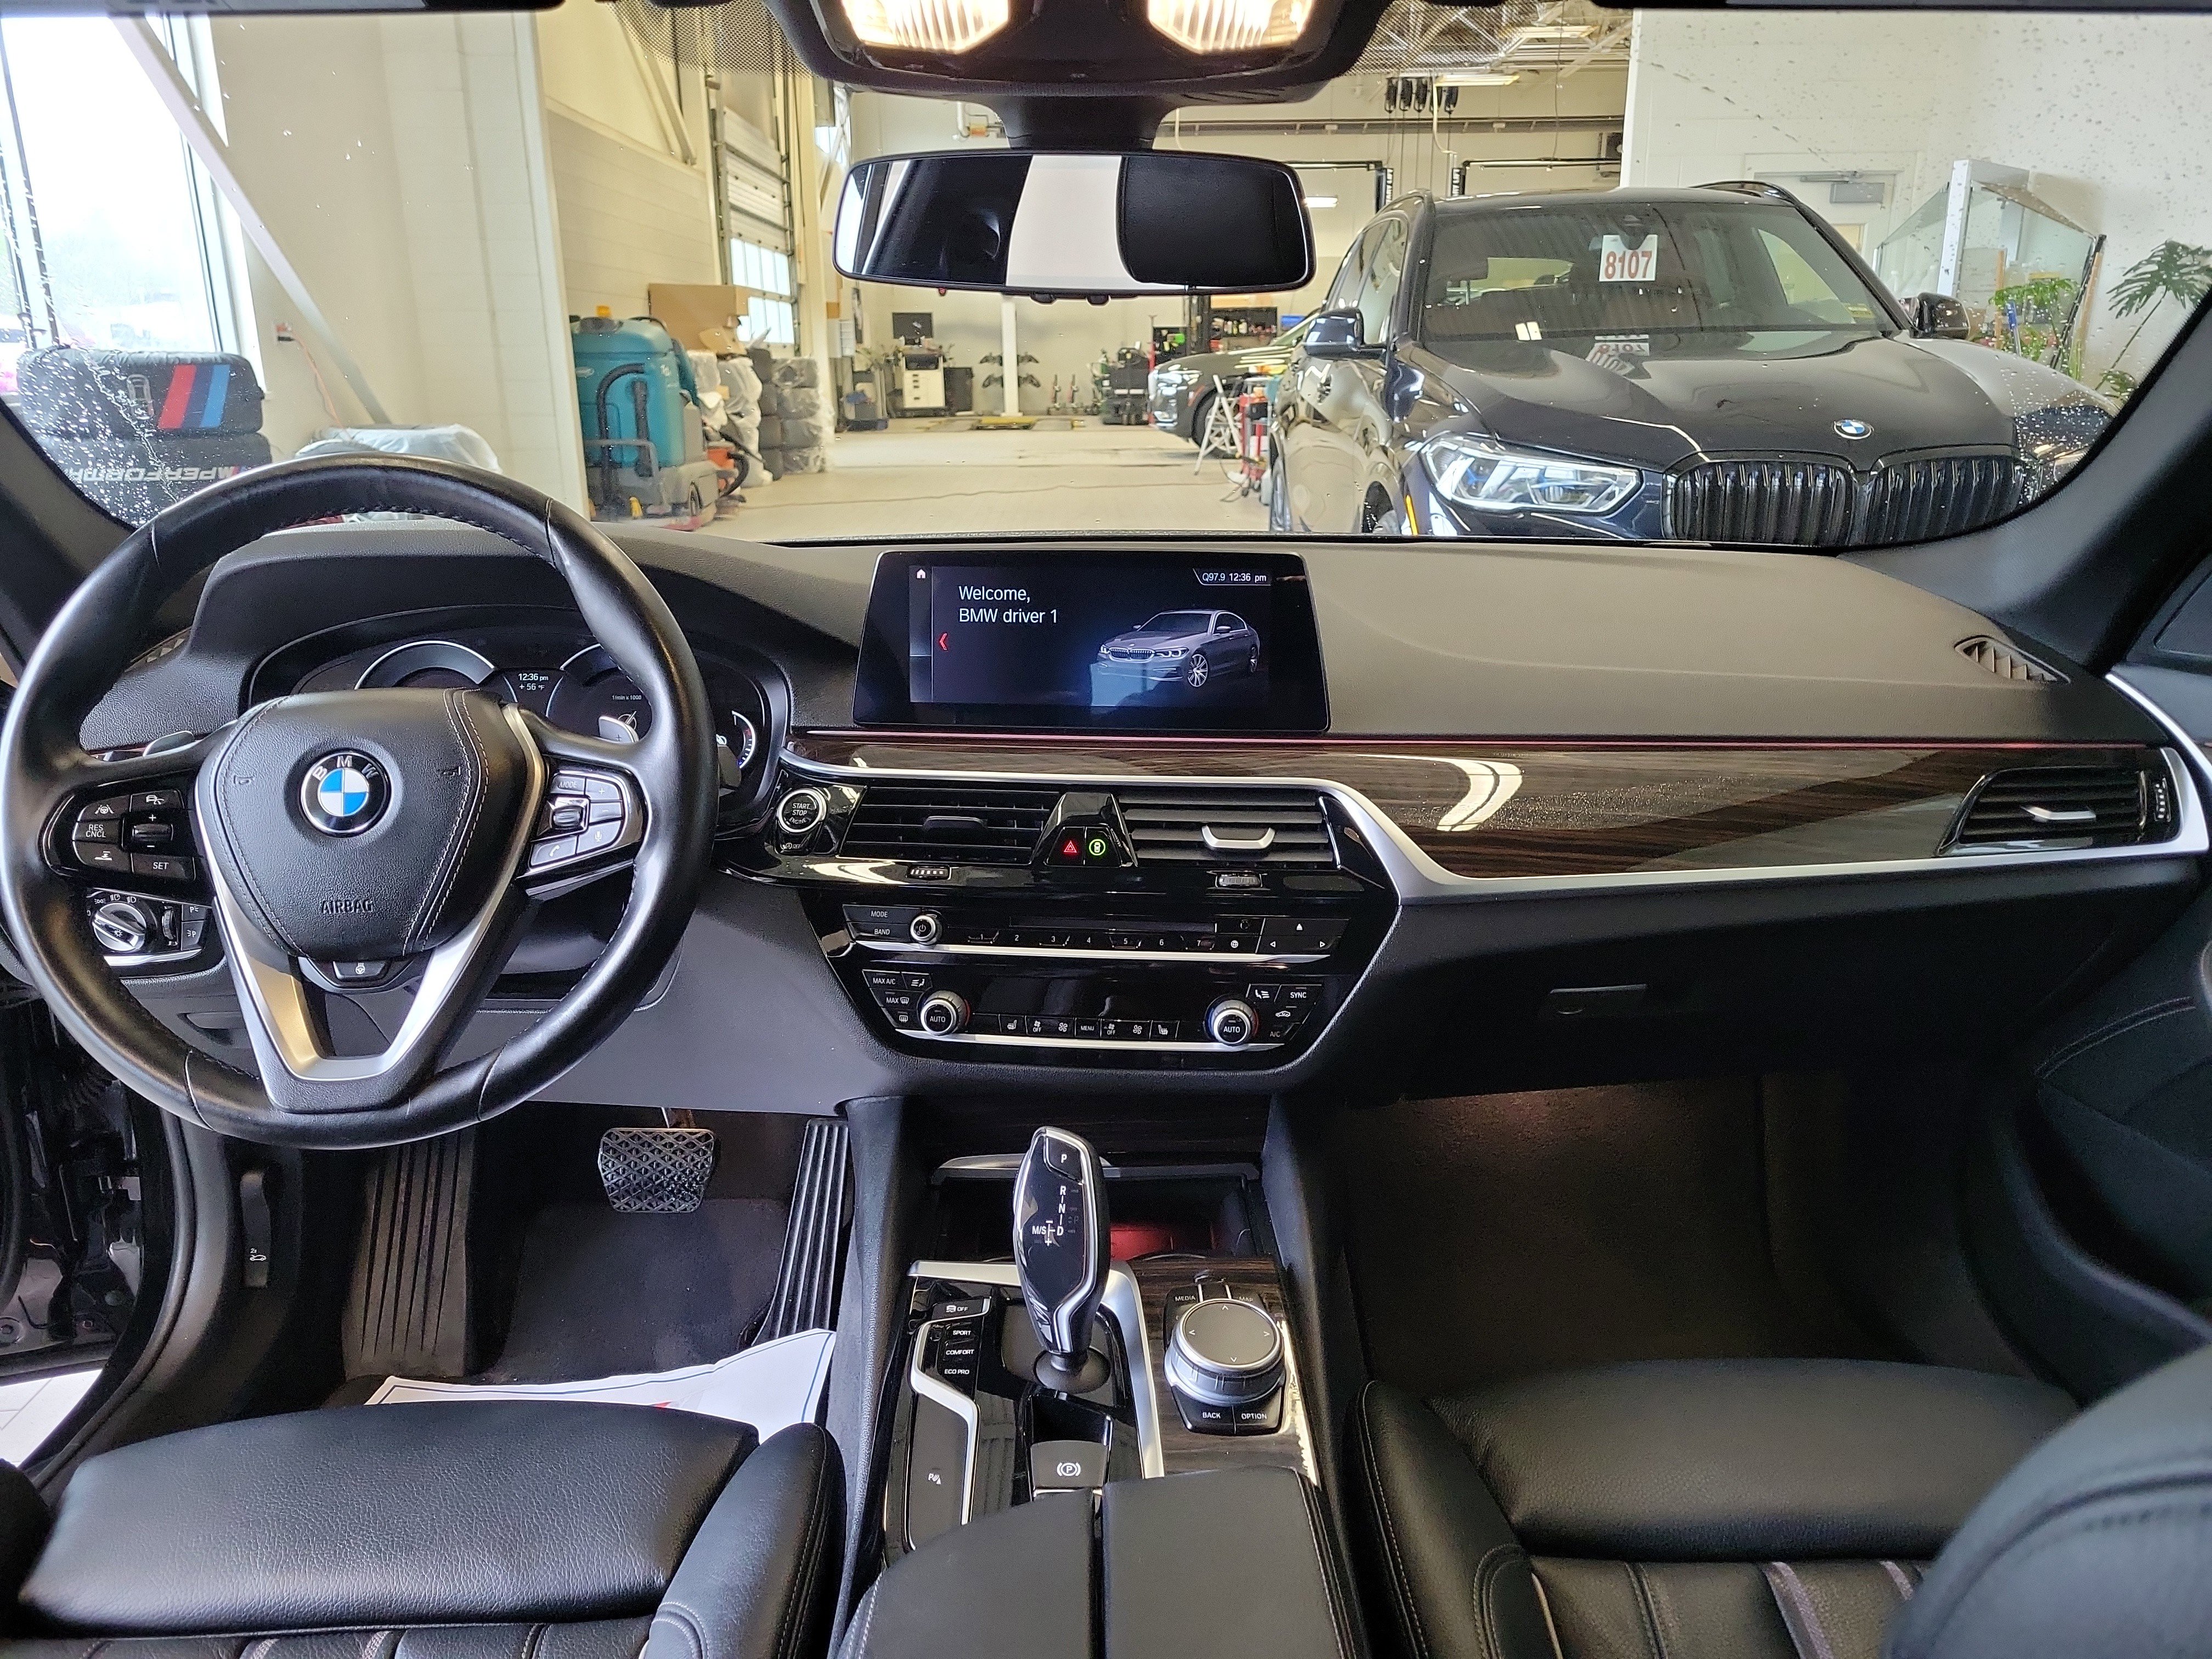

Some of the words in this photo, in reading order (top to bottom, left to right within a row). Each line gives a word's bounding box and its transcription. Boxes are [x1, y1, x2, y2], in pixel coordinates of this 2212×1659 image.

[1604, 250, 1652, 279] 8107
[1202, 573, 1226, 582] Q97.9
[1229, 573, 1251, 582] 12:36
[1254, 575, 1267, 583] pm
[958, 586, 1030, 603] Welcome,
[959, 608, 998, 623] BMW
[1003, 608, 1046, 623] driver
[1050, 609, 1058, 623] 1
[312, 755, 380, 781] BMW
[321, 899, 374, 914] AIRBAG
[1061, 1154, 1067, 1163] P
[1060, 1185, 1066, 1195] R
[1059, 1204, 1065, 1214] N
[1032, 1226, 1047, 1235] M/S
[1057, 1226, 1064, 1235] D
